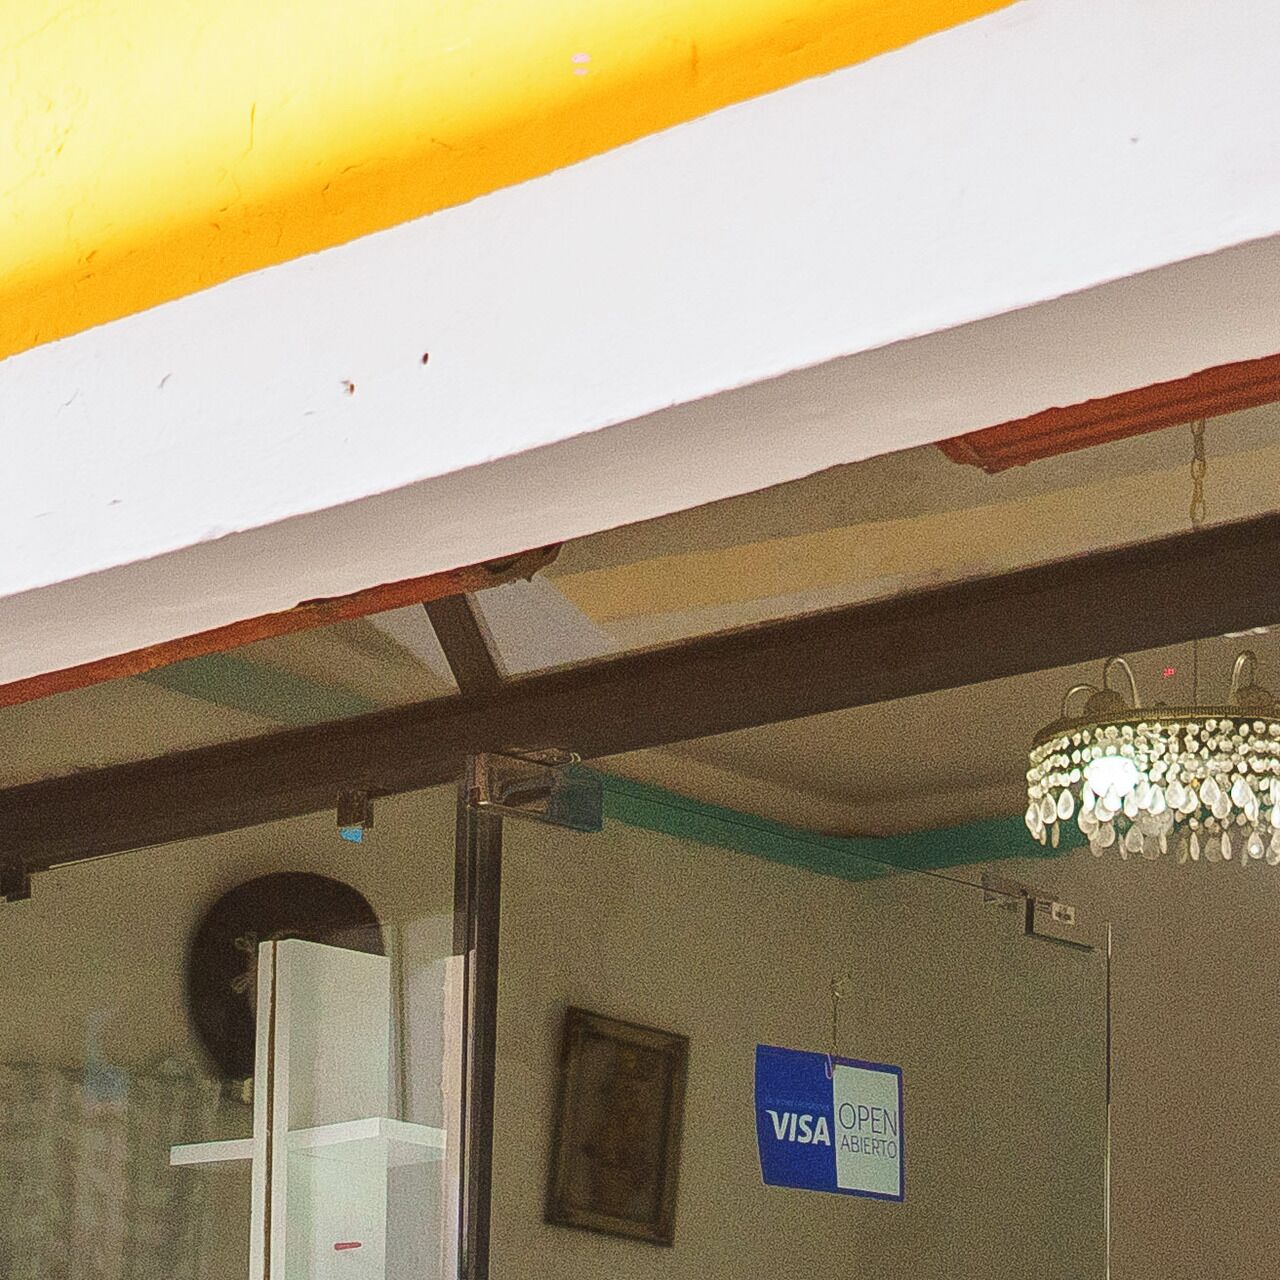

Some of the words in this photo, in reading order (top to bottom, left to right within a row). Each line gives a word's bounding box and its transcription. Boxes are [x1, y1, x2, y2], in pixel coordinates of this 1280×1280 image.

[765, 1109, 831, 1146] VISA
[839, 1102, 897, 1137] OPEN
[839, 1135, 897, 1159] ABIERTO
